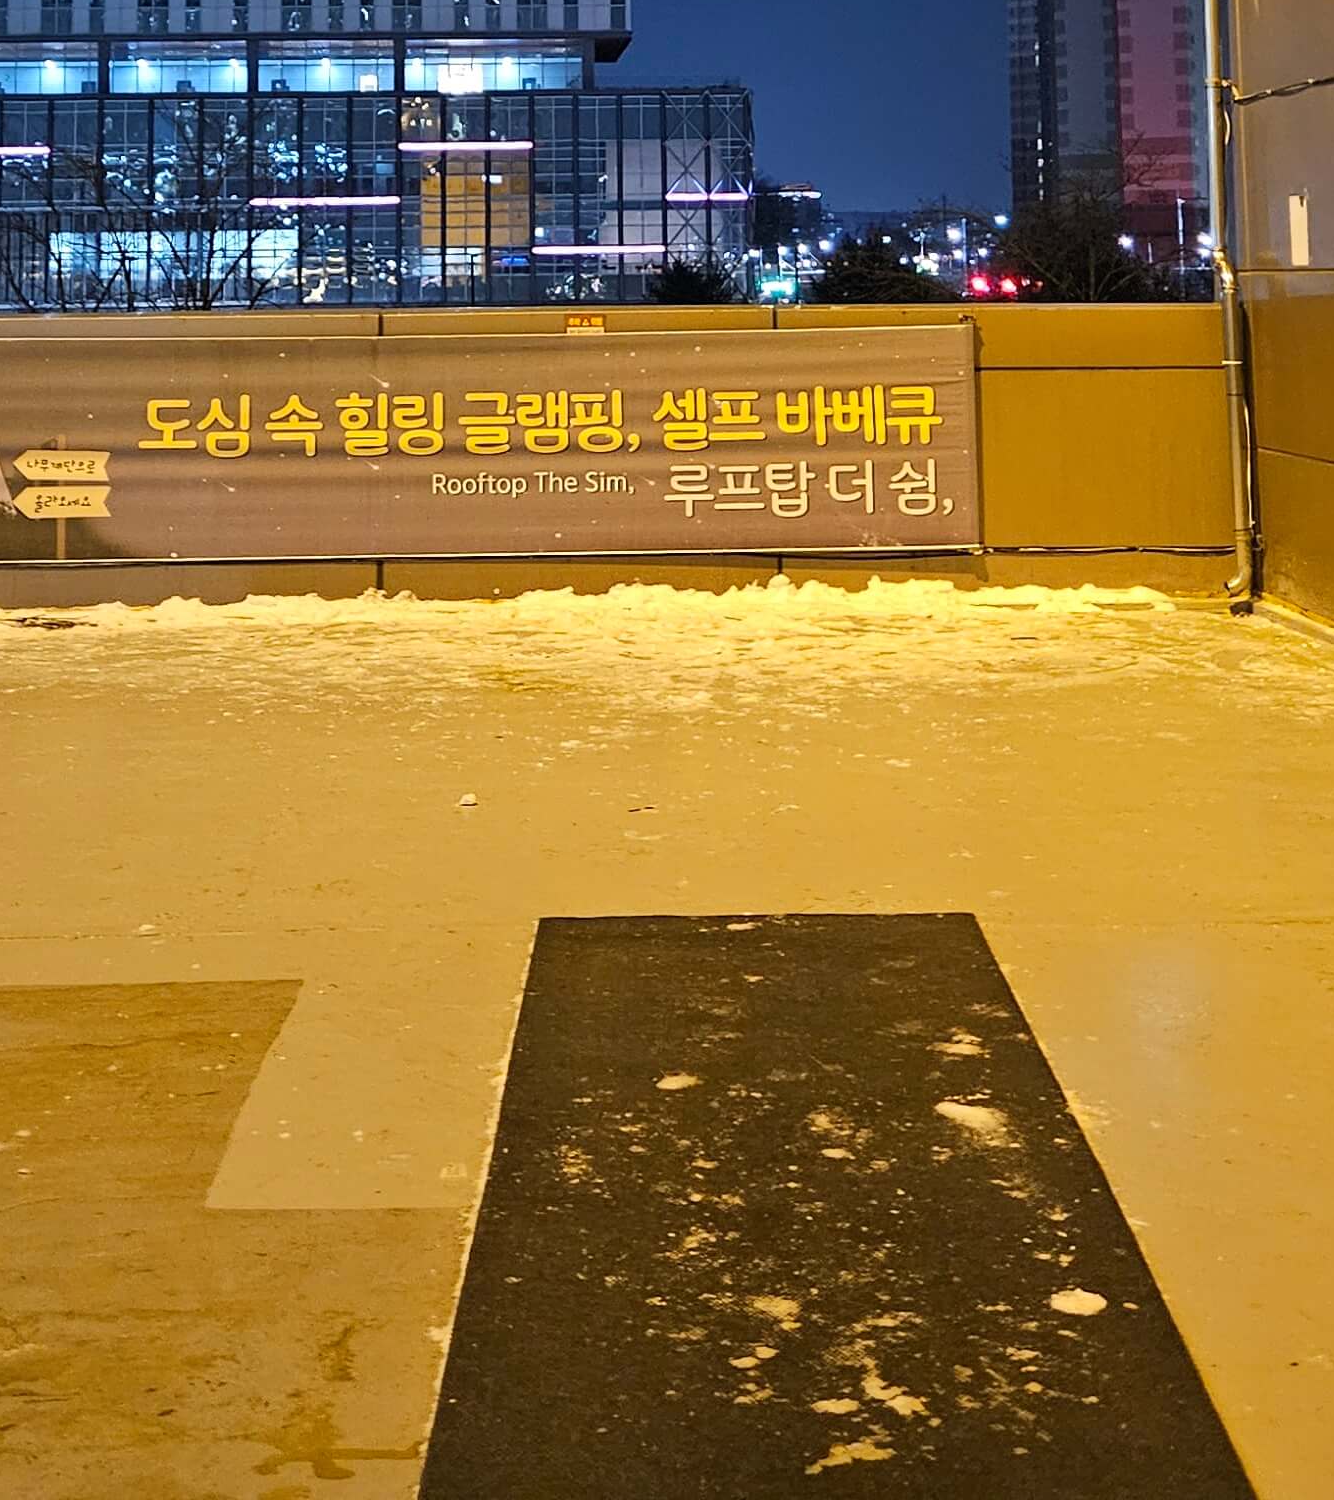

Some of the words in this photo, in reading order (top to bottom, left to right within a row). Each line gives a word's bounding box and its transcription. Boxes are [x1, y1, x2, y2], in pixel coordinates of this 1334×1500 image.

[137, 394, 251, 458] 도심
[264, 394, 323, 456] 속
[334, 391, 445, 456] 힐링
[457, 389, 641, 455] 글램핑,
[652, 387, 767, 451] 셀프
[776, 385, 943, 445] 바베큐
[431, 472, 527, 499] Rooftop
[533, 471, 578, 493] The
[584, 470, 635, 496] Sim,
[663, 460, 816, 518] 루프탑
[823, 457, 876, 514] 더
[887, 456, 955, 518] 쉼,
